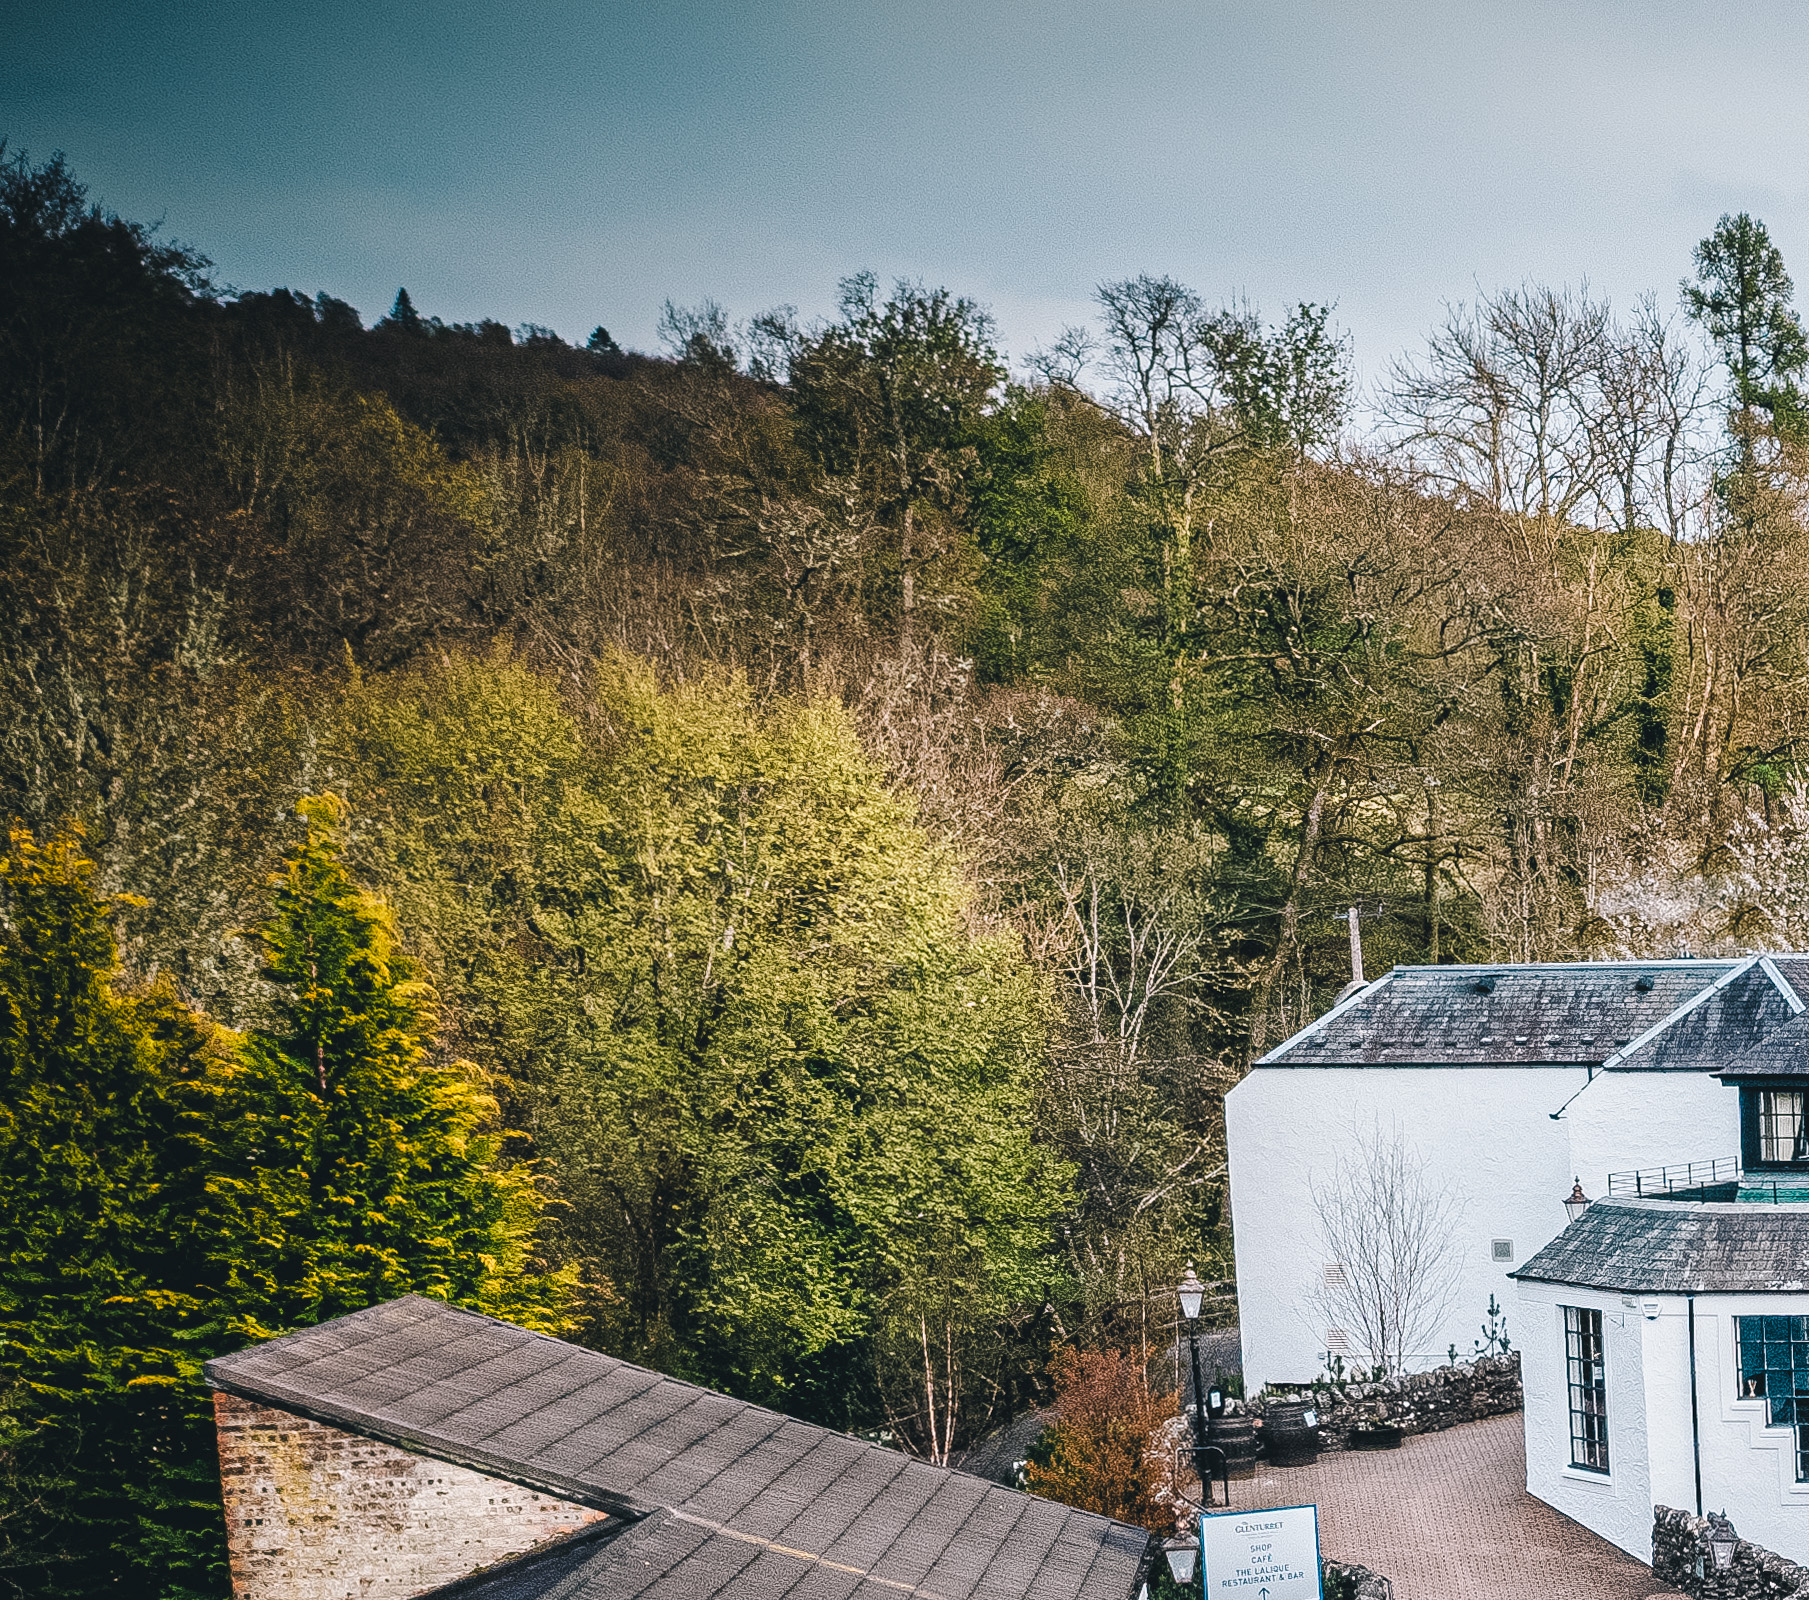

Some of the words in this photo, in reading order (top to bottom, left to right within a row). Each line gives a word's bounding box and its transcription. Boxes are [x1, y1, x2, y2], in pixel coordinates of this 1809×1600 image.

[1250, 1543, 1272, 1553] SHOP
[1236, 1568, 1251, 1577] THE
[1255, 1564, 1290, 1575] LALIQUE
[1222, 1574, 1276, 1587] RESTAURANT
[1288, 1571, 1304, 1579] BAR
